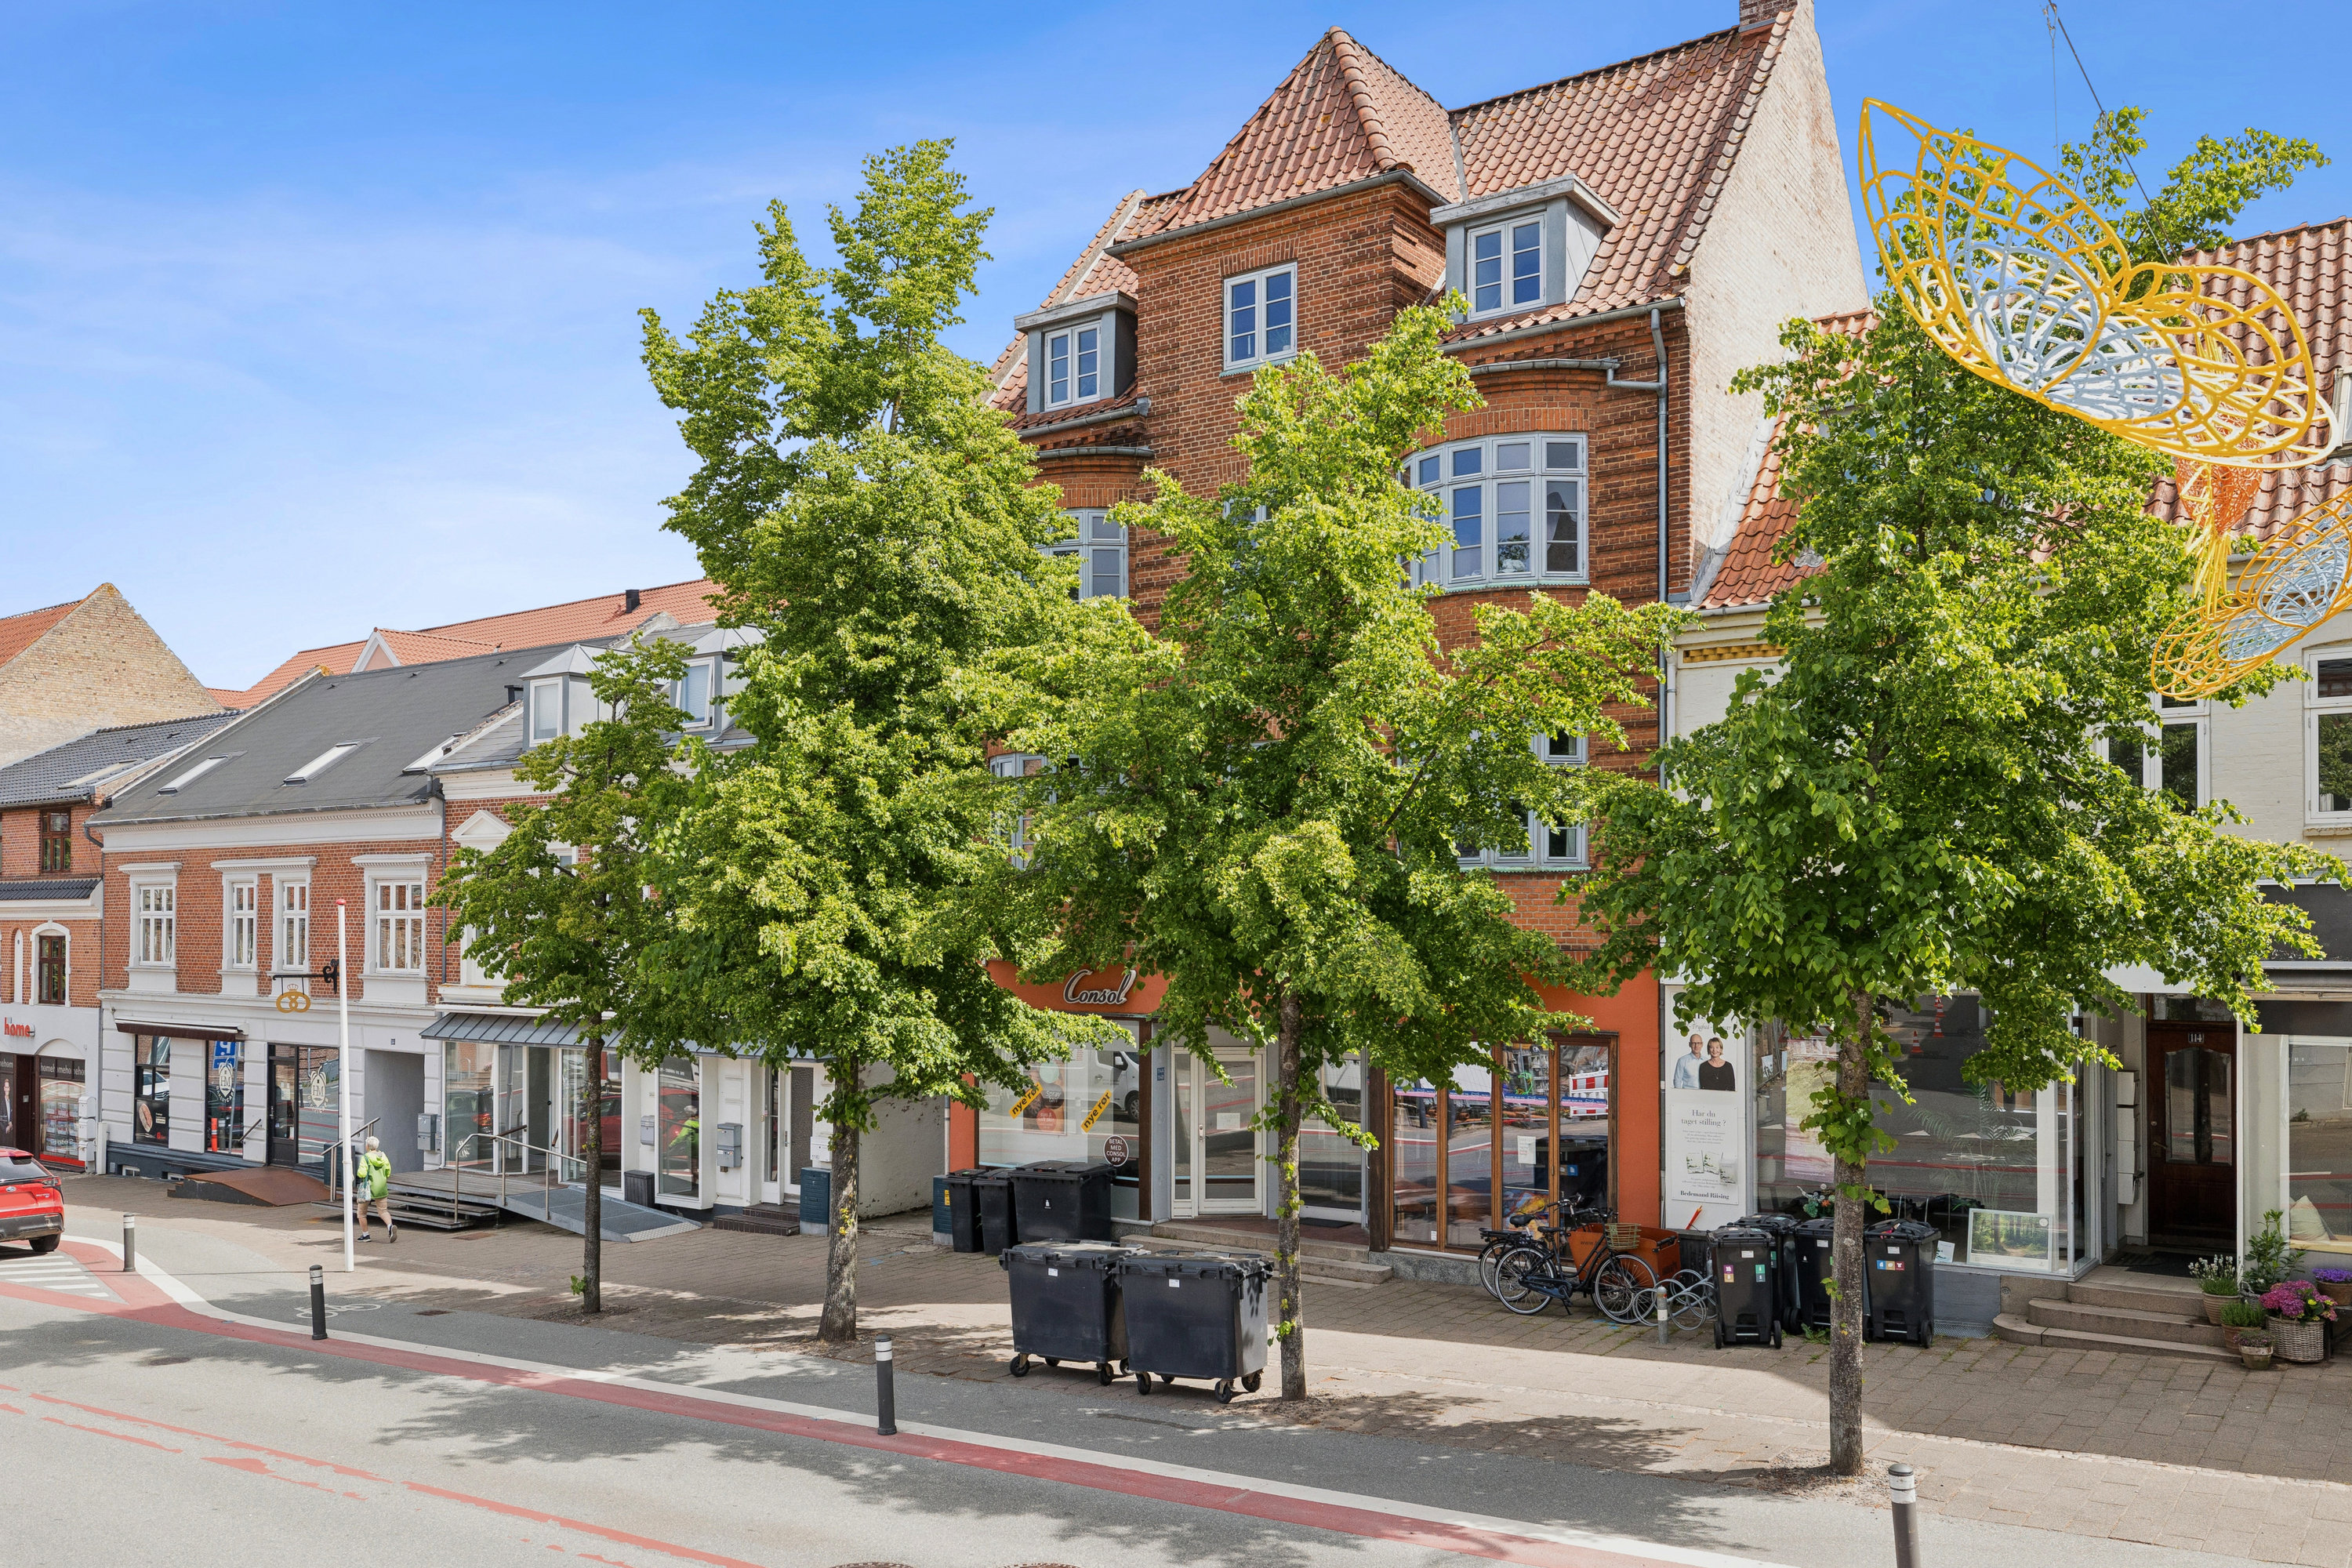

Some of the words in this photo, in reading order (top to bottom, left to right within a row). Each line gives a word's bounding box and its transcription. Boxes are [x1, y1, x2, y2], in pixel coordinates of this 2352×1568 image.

[1063, 969, 1137, 1004] Consol
[4, 1017, 31, 1037] home
[2190, 1033, 2202, 1043] 114
[1011, 1095, 1027, 1115] nye
[1083, 1109, 1098, 1128] nye
[1098, 1092, 1110, 1109] rør
[1699, 1118, 1721, 1127] stilling
